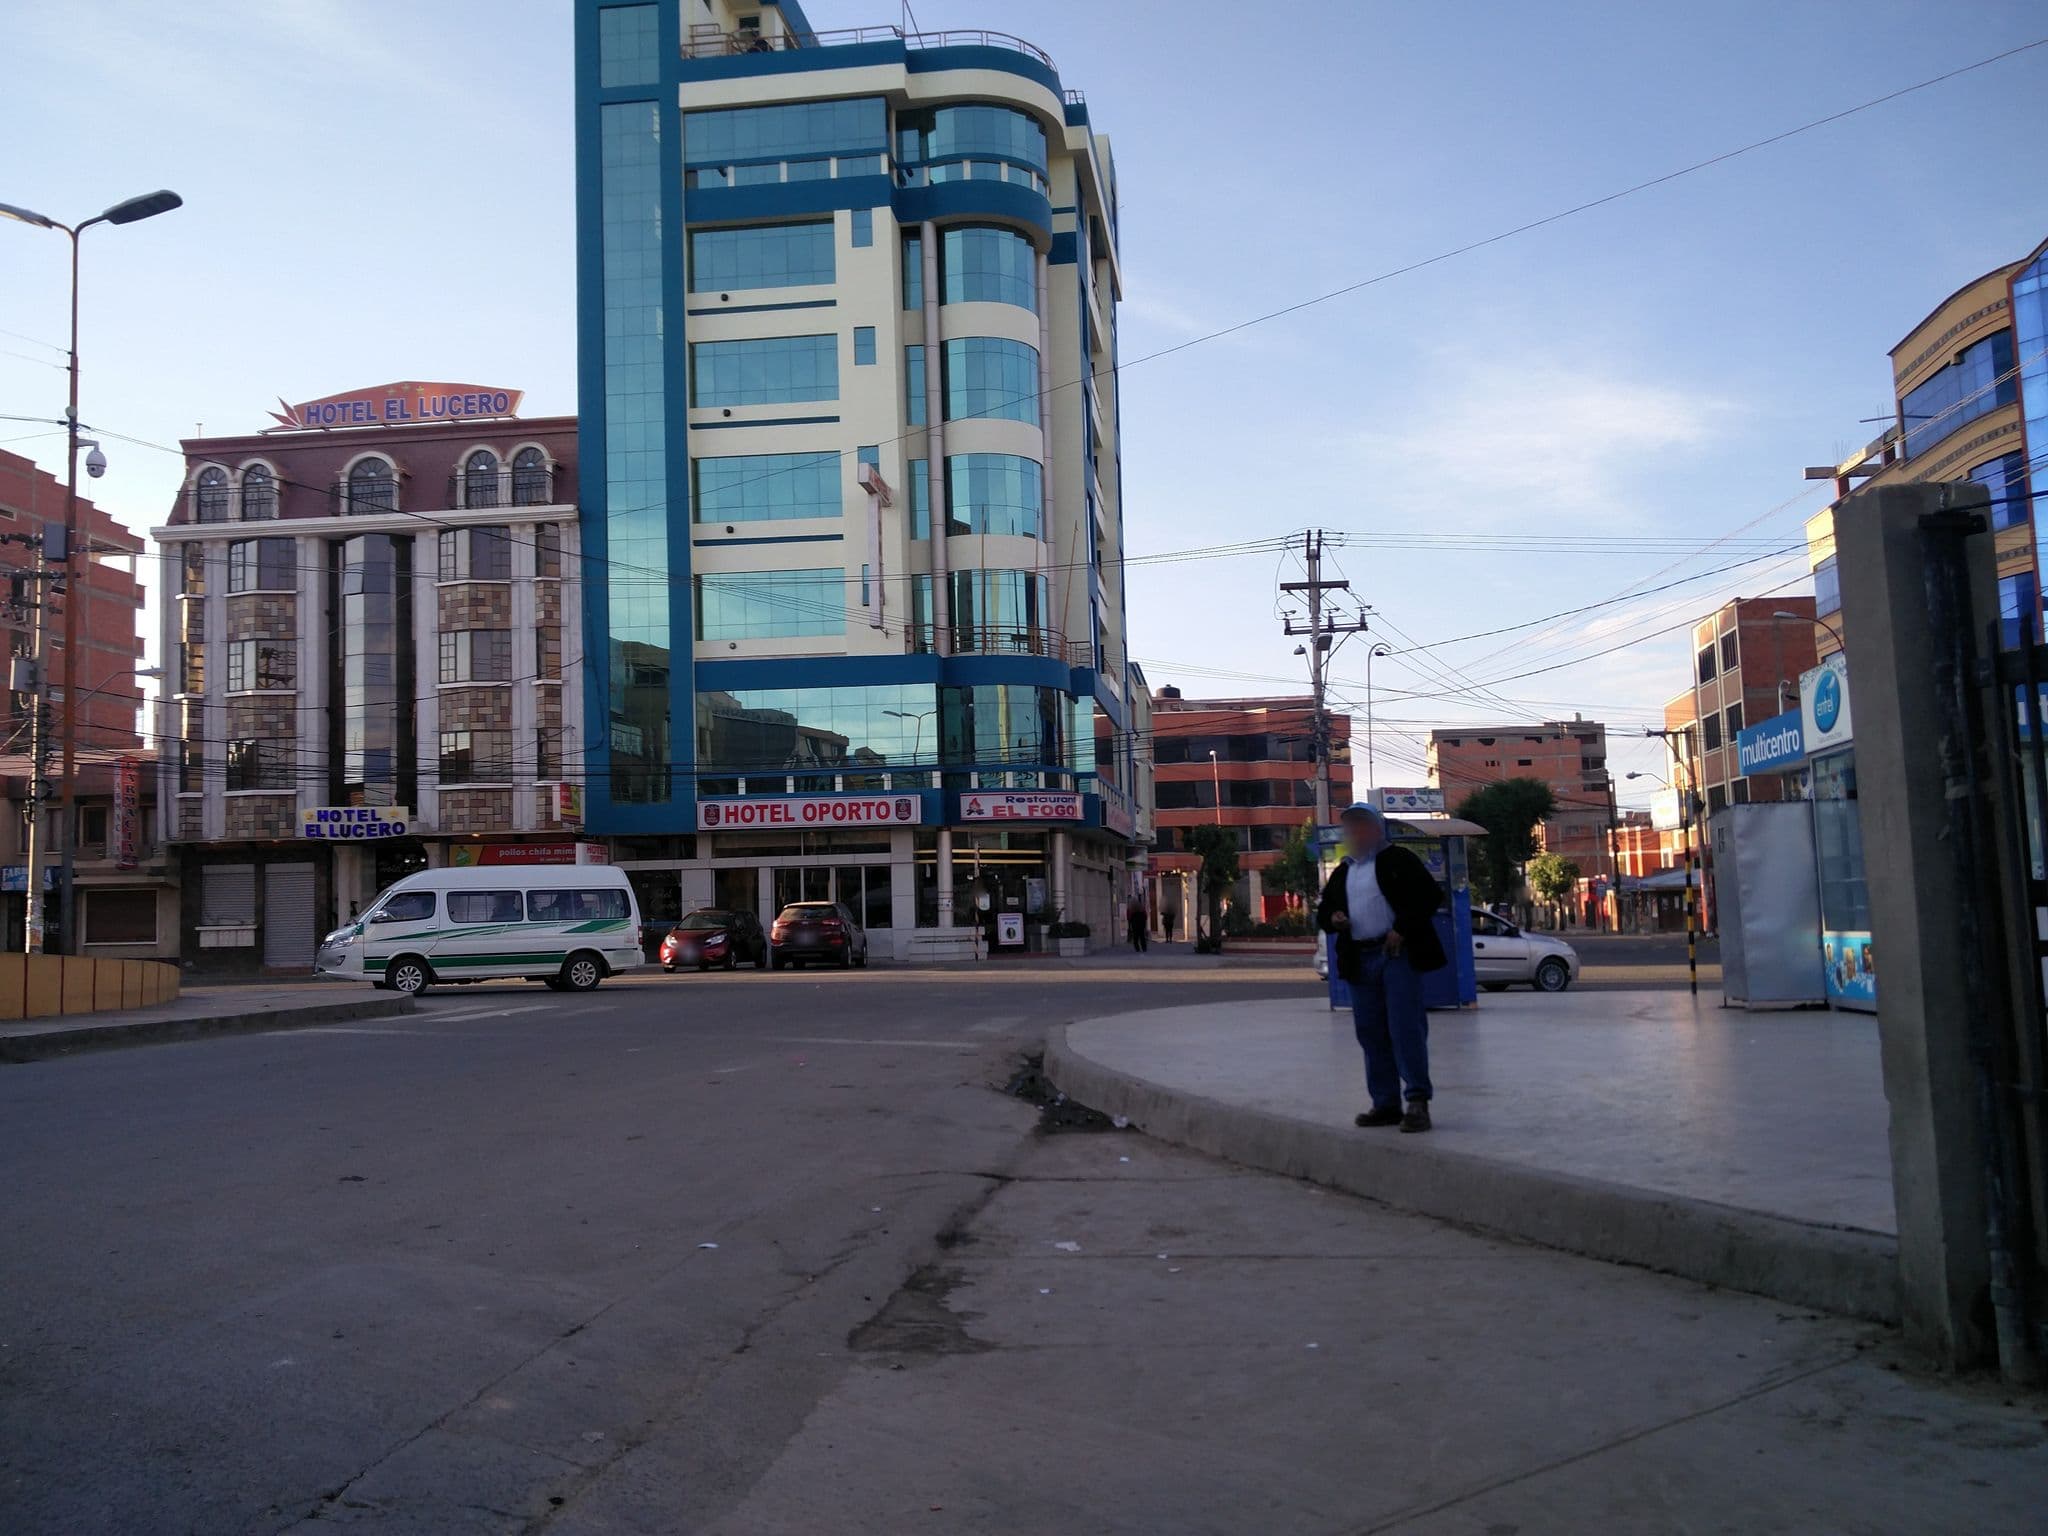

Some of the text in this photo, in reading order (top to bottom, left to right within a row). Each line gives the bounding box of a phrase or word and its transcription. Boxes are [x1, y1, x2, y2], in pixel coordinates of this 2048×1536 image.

[306, 393, 509, 425] HOTEL EL LUCERO
[1742, 727, 1800, 767] multicentro
[1005, 795, 1077, 804] Restaurant
[316, 809, 382, 823] HOTEL
[724, 801, 891, 824] HOTEL OPORTO
[992, 804, 1078, 817] EL FOGO
[305, 821, 406, 838] EL LUCERO
[499, 848, 526, 858] pollos
[529, 847, 551, 857] chifa
